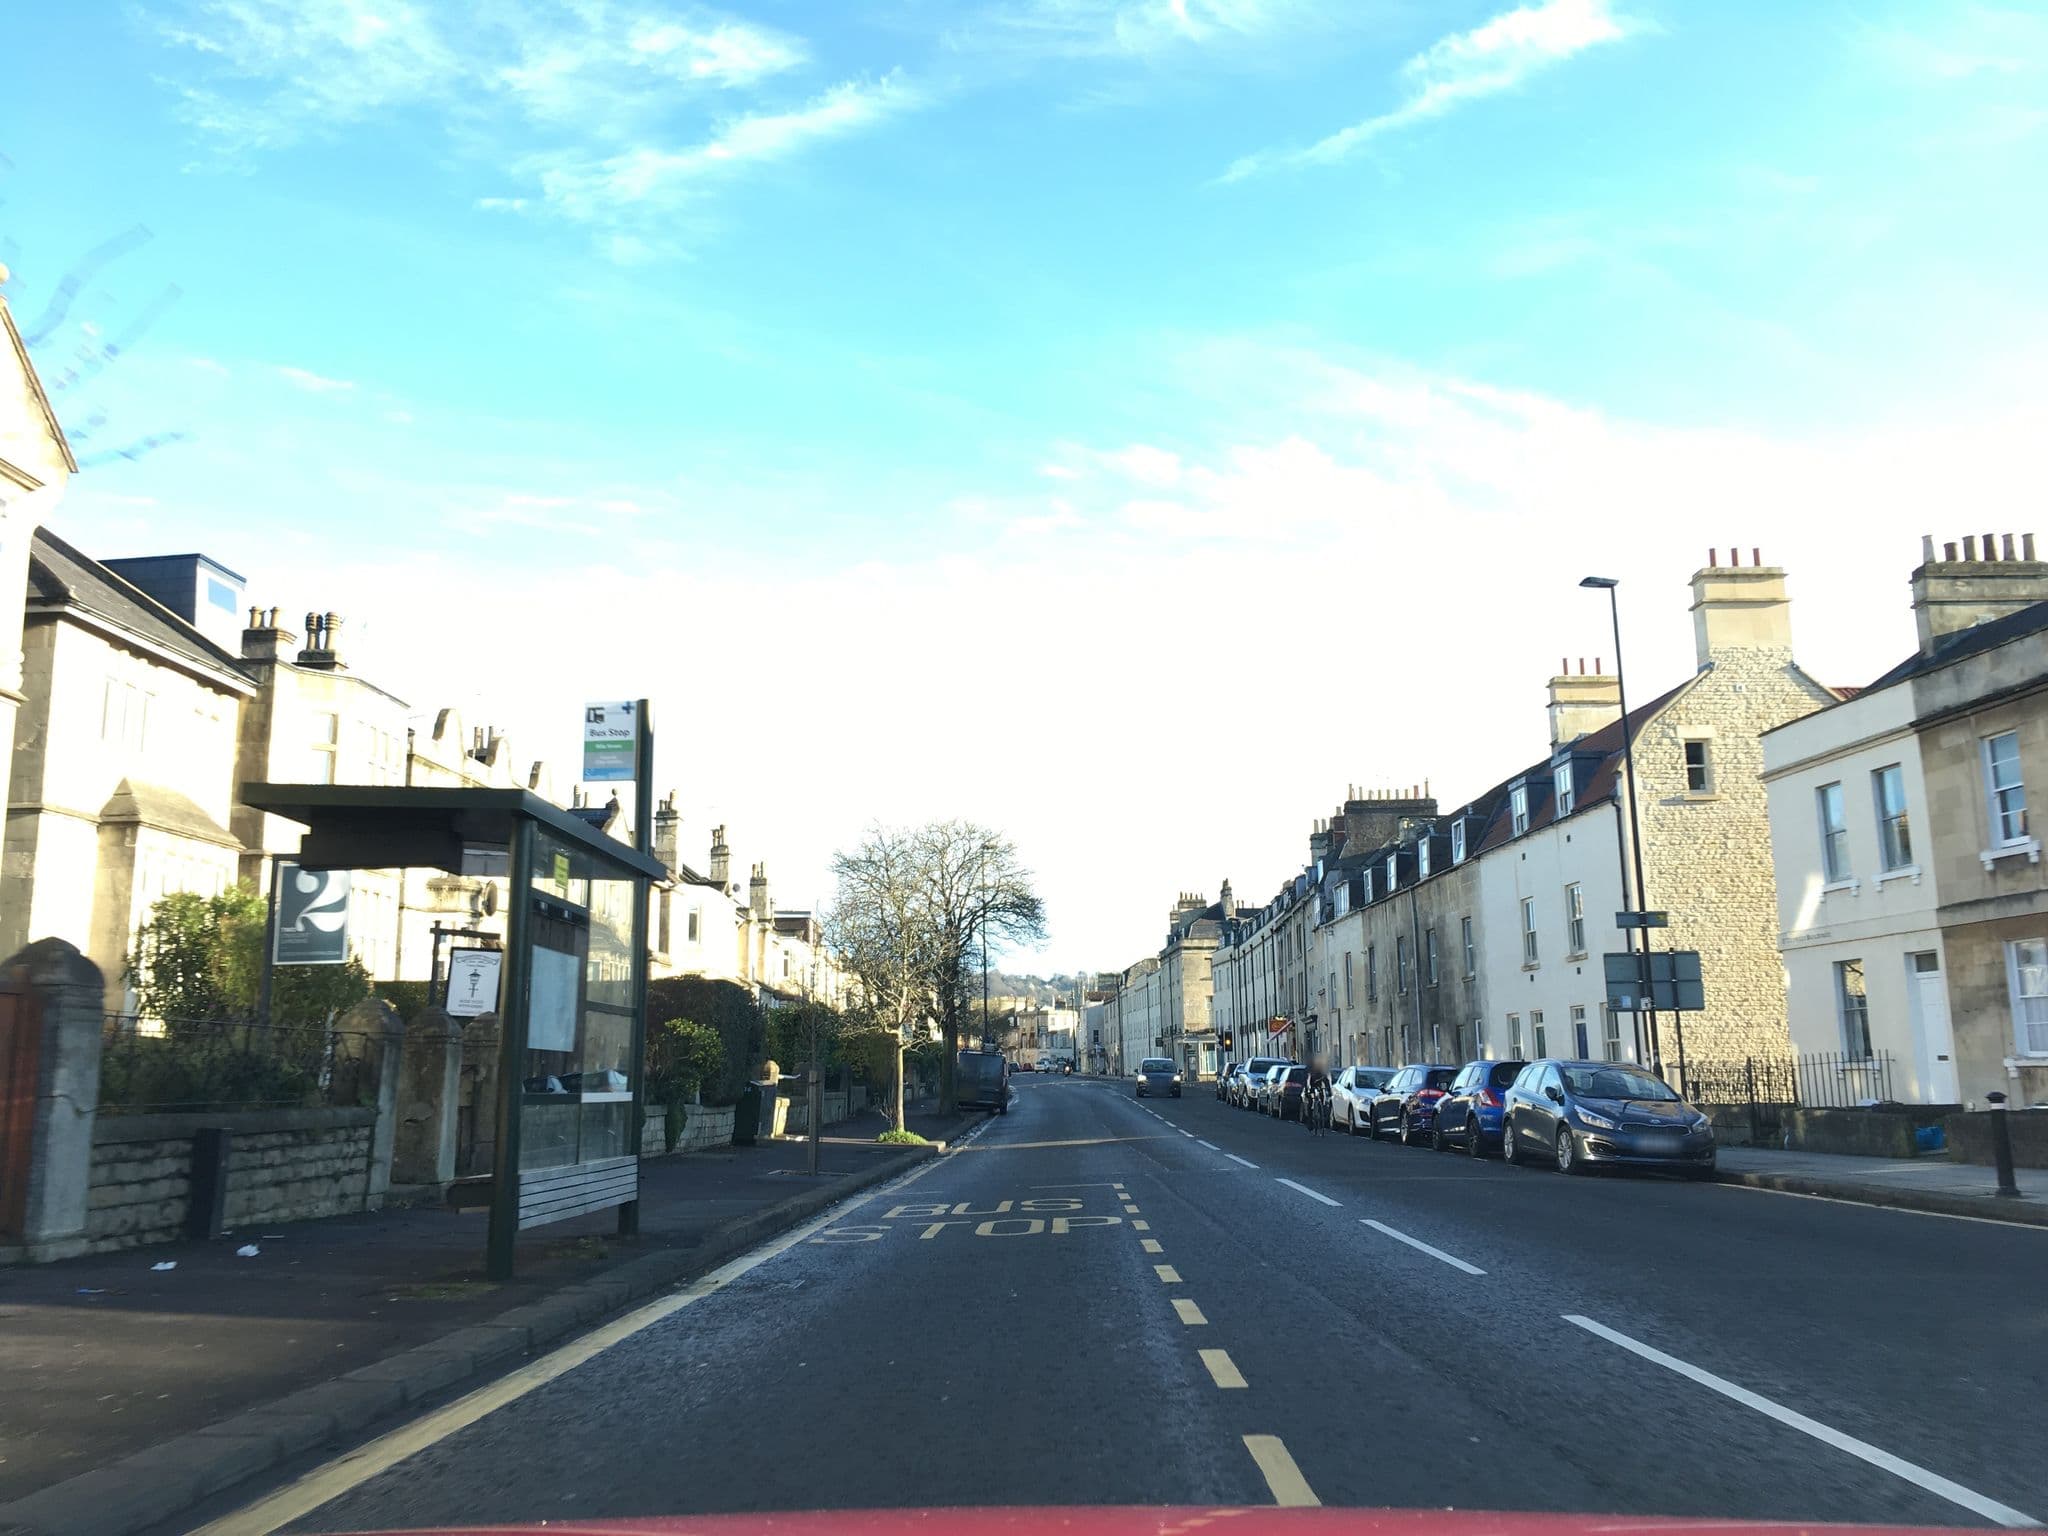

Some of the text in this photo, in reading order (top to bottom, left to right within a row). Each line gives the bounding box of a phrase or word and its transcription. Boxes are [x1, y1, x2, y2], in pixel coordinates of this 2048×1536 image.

[590, 728, 630, 738] Bus Stop
[881, 1198, 1083, 1218] BUS
[809, 1216, 1122, 1244] STOP
